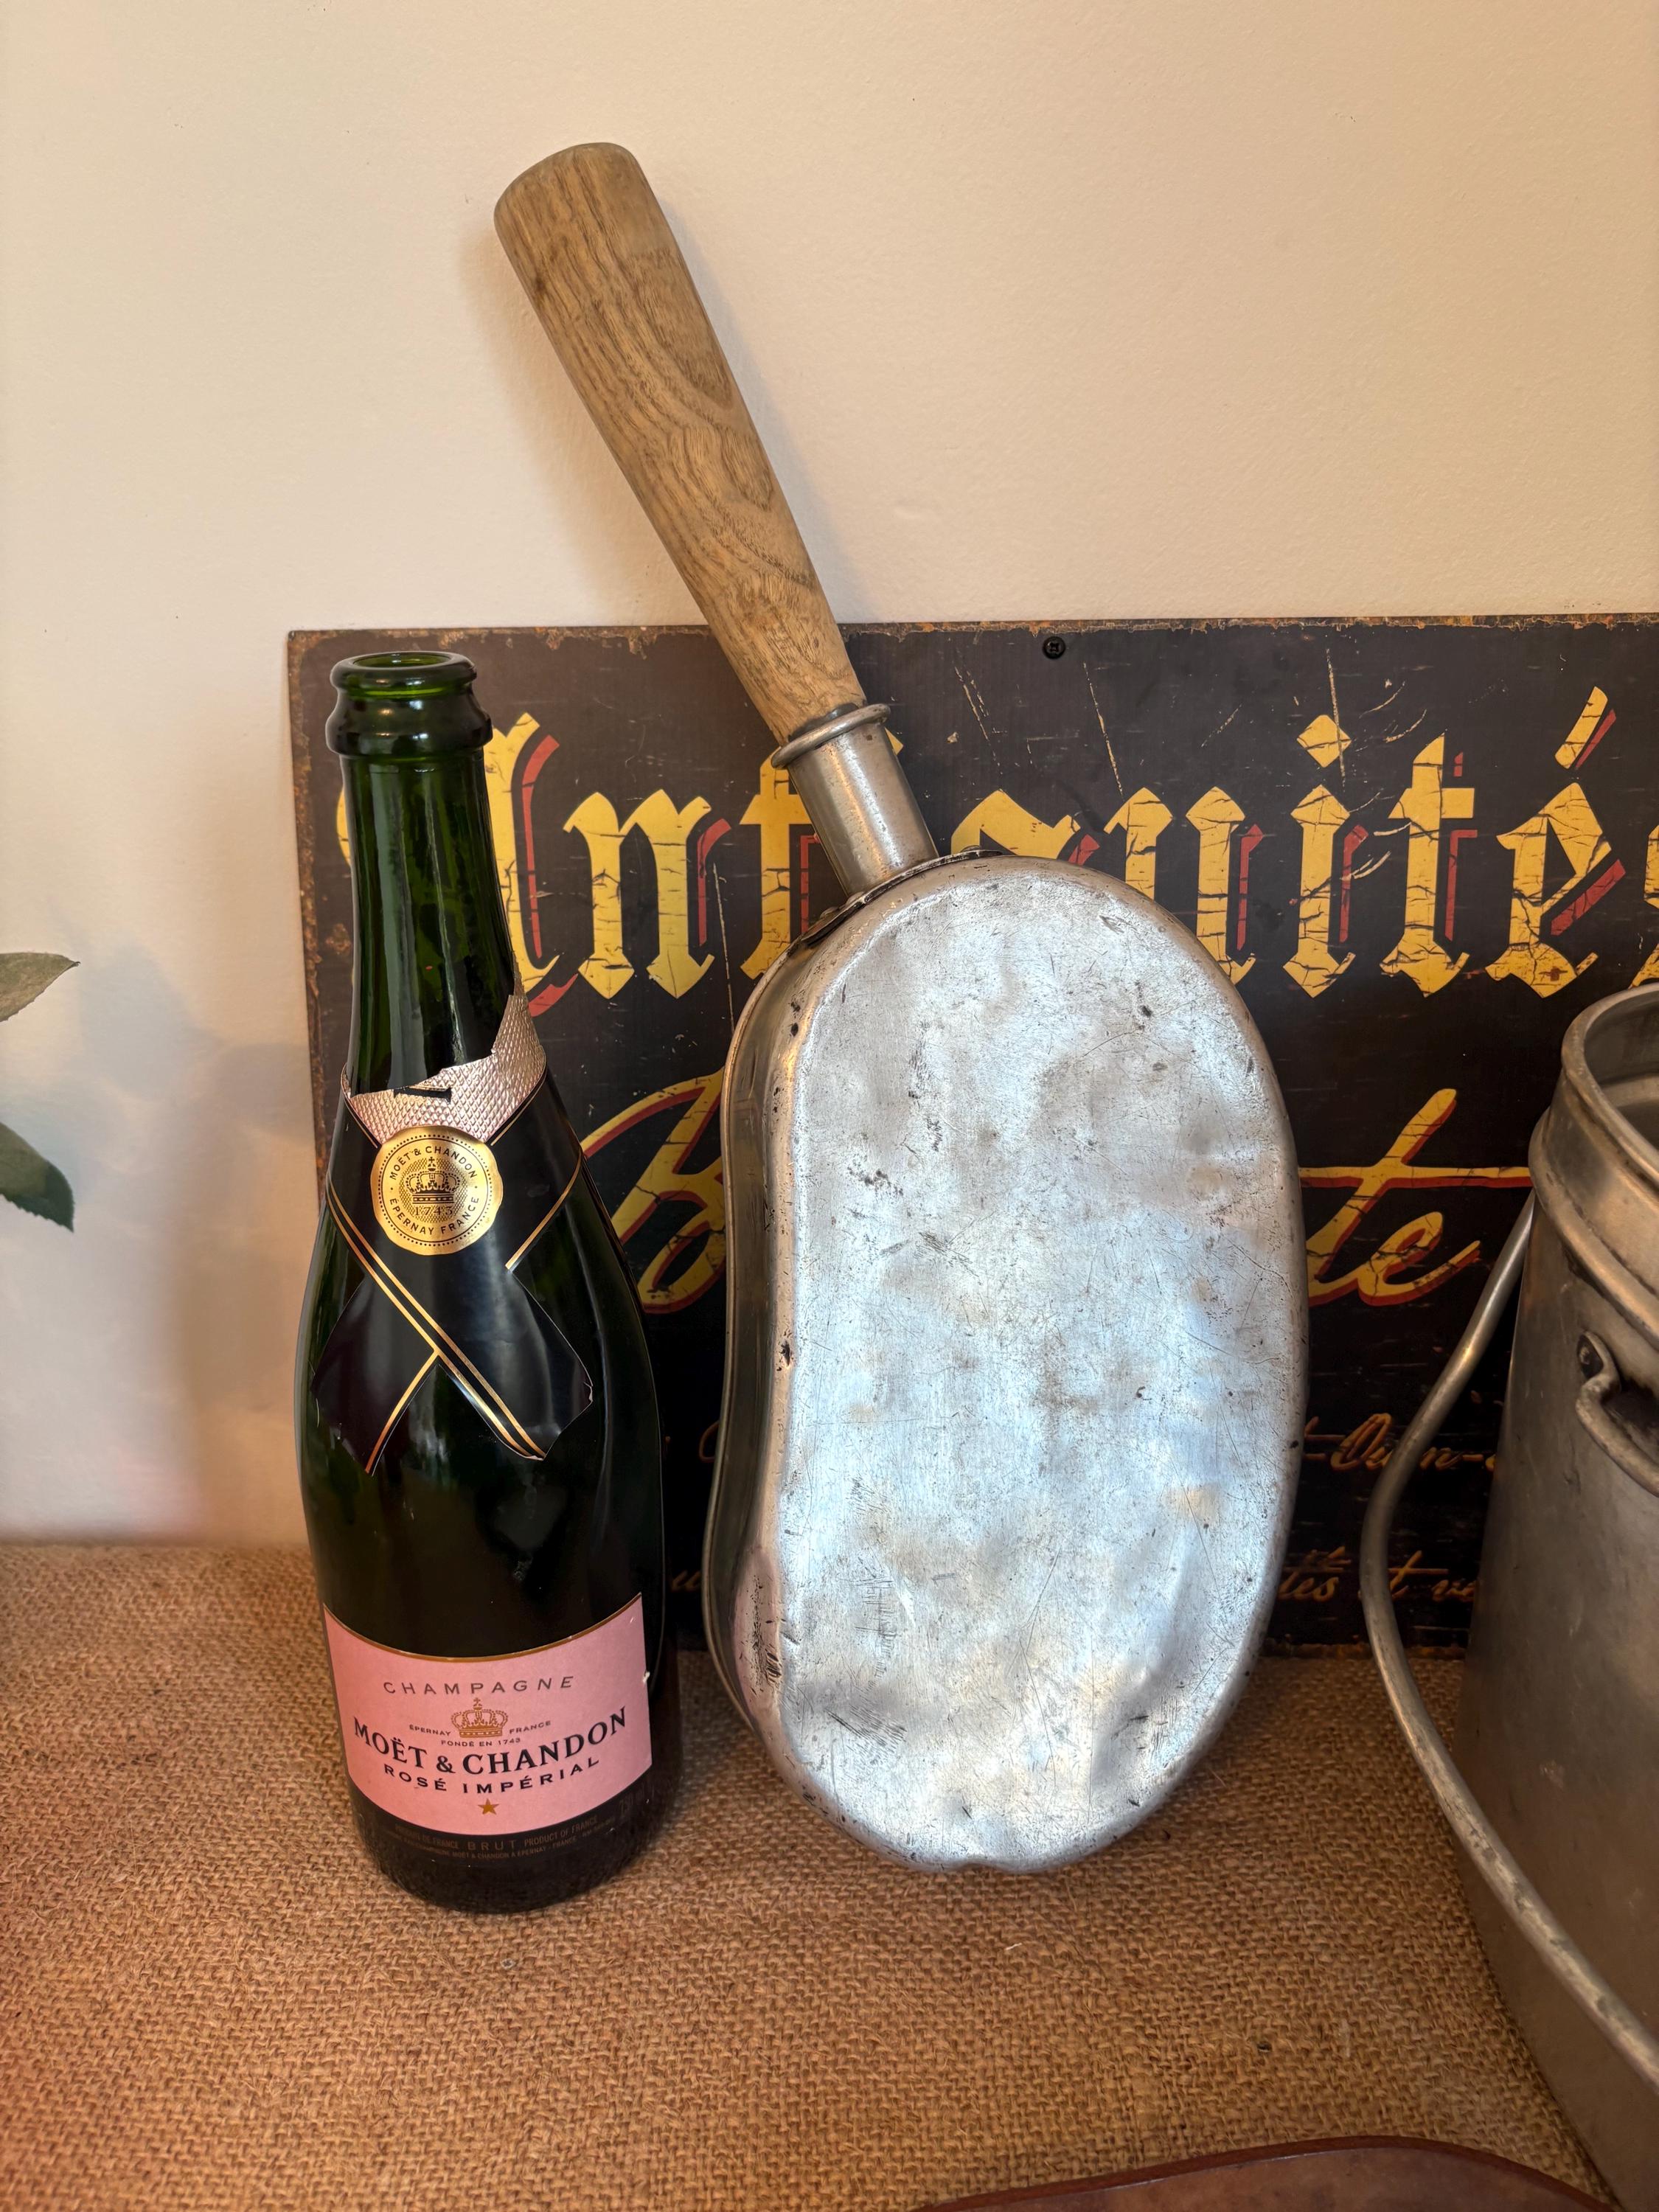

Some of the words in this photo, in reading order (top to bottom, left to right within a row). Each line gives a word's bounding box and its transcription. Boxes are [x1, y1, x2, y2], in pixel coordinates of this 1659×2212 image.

[389, 1151, 411, 1180] MOËT
[414, 1148, 422, 1156] &
[425, 1146, 478, 1179] CHANDON
[414, 1206, 453, 1217] 1743
[440, 1197, 479, 1234] FRANCE
[383, 1675, 575, 1695] CHAMPAGNE
[354, 1716, 427, 1769] MOËT
[436, 1755, 454, 1774] &
[462, 1705, 627, 1776] CHANDON
[509, 1720, 552, 1735] FRANCE
[383, 1763, 448, 1792] ROSÉ
[462, 1756, 600, 1795] IMPÉRIAL
[467, 1840, 517, 1851] BRUT
[524, 1832, 558, 1848] PRODUCT
[571, 1815, 598, 1834] FRANCE
